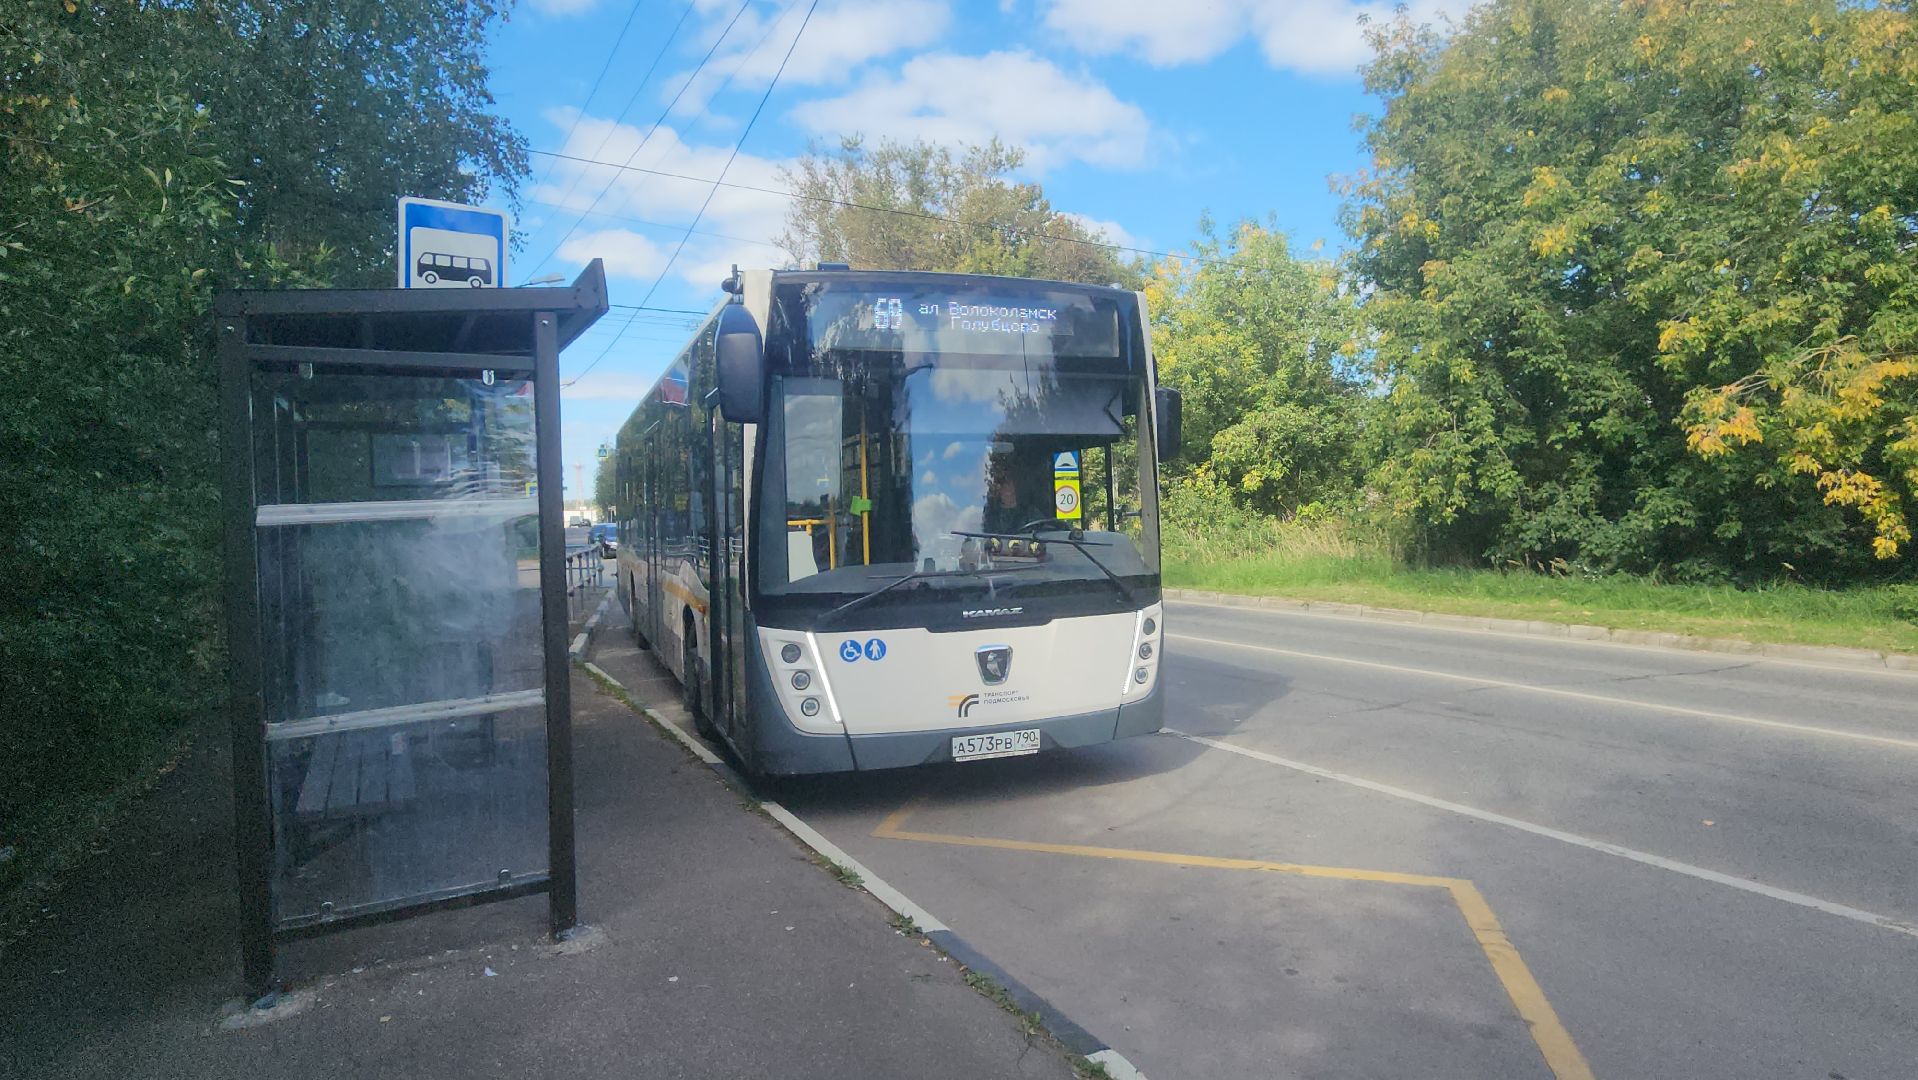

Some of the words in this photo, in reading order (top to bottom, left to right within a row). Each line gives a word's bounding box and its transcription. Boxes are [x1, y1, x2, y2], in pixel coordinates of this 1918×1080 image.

[948, 301, 1057, 320] Волоколамск
[950, 316, 1040, 333] Голубцово
[1060, 493, 1074, 505] 20
[1015, 731, 1036, 744] 790
